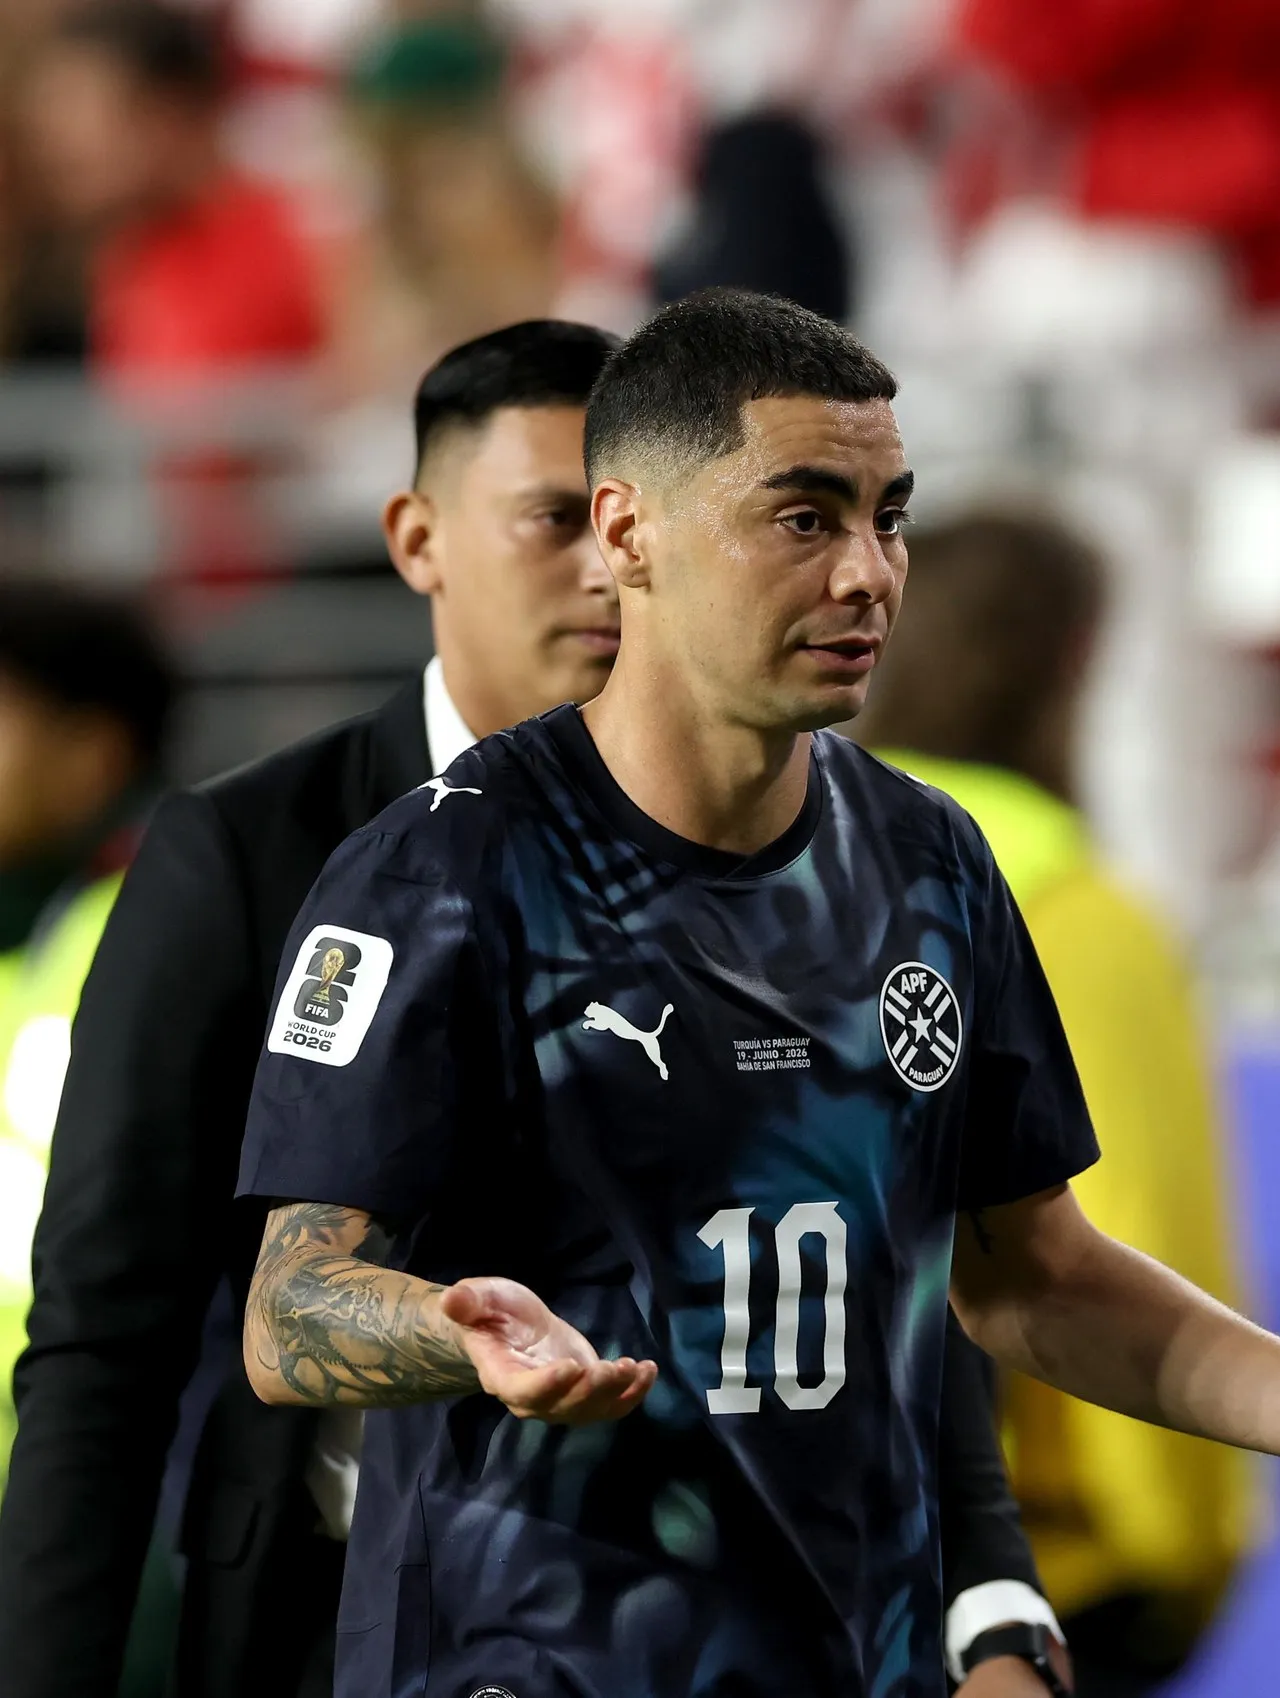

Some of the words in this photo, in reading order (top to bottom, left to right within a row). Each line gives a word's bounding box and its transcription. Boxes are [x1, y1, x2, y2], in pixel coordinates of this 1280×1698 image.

[901, 972, 928, 994] APF
[304, 1003, 330, 1019] FIFA
[287, 1021, 318, 1035] WORLD
[318, 1029, 337, 1039] CUP
[283, 1030, 333, 1052] 2026
[733, 1037, 761, 1050] TURQUÍA
[762, 1039, 771, 1049] VS
[772, 1037, 811, 1048] PARAGUAY
[737, 1051, 746, 1060] 19
[753, 1050, 779, 1060] JUNIO
[785, 1048, 808, 1058] 2026
[754, 1062, 762, 1070] DE
[762, 1061, 775, 1070] SAN
[776, 1059, 811, 1069] FRANCISCO
[908, 1064, 944, 1083] PARAGUAY
[696, 1201, 848, 1415] 10
